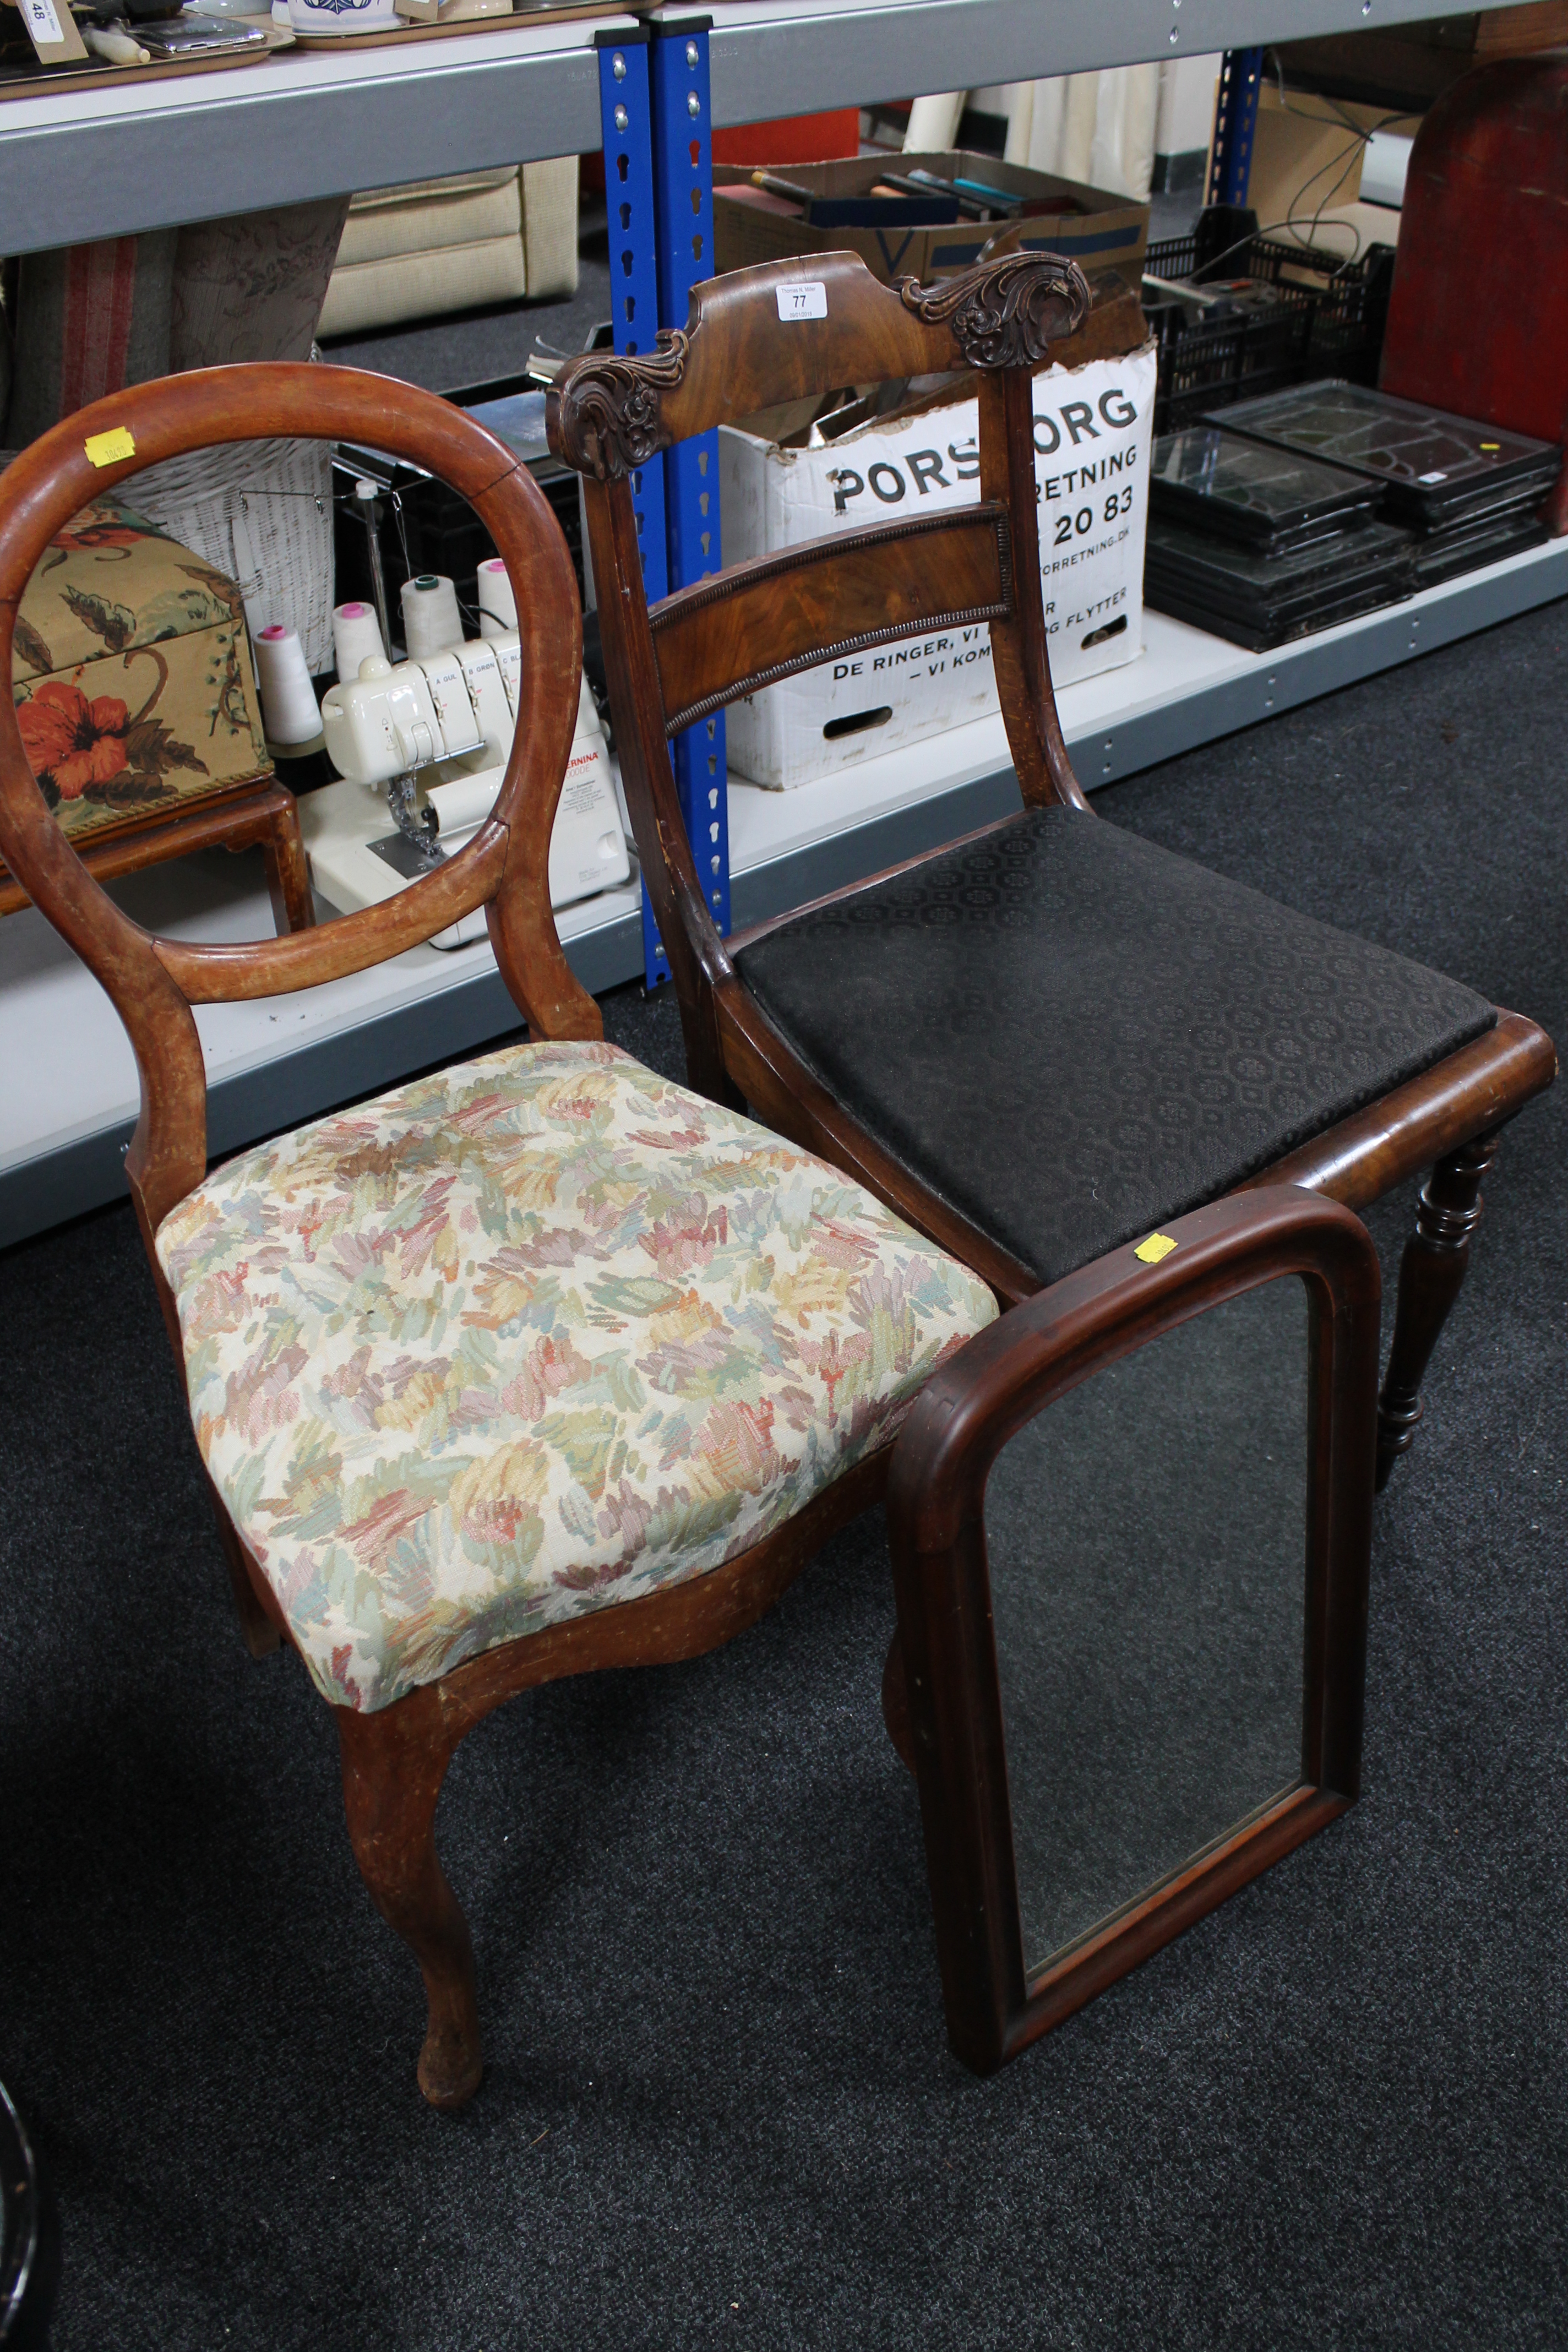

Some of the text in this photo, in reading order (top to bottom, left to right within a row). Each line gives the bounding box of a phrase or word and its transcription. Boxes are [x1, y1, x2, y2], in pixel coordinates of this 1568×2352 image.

[32, 3, 45, 20] 48
[793, 295, 806, 308] 77
[1054, 506, 1092, 546] 20
[1103, 484, 1133, 522] 83
[929, 661, 944, 676] VI
[1066, 586, 1126, 628] FLYTTER
[833, 627, 978, 680] DE RINGER, VI
[476, 662, 495, 673] GRØN
[443, 674, 457, 683] GUL
[567, 752, 598, 769] ERNINA
